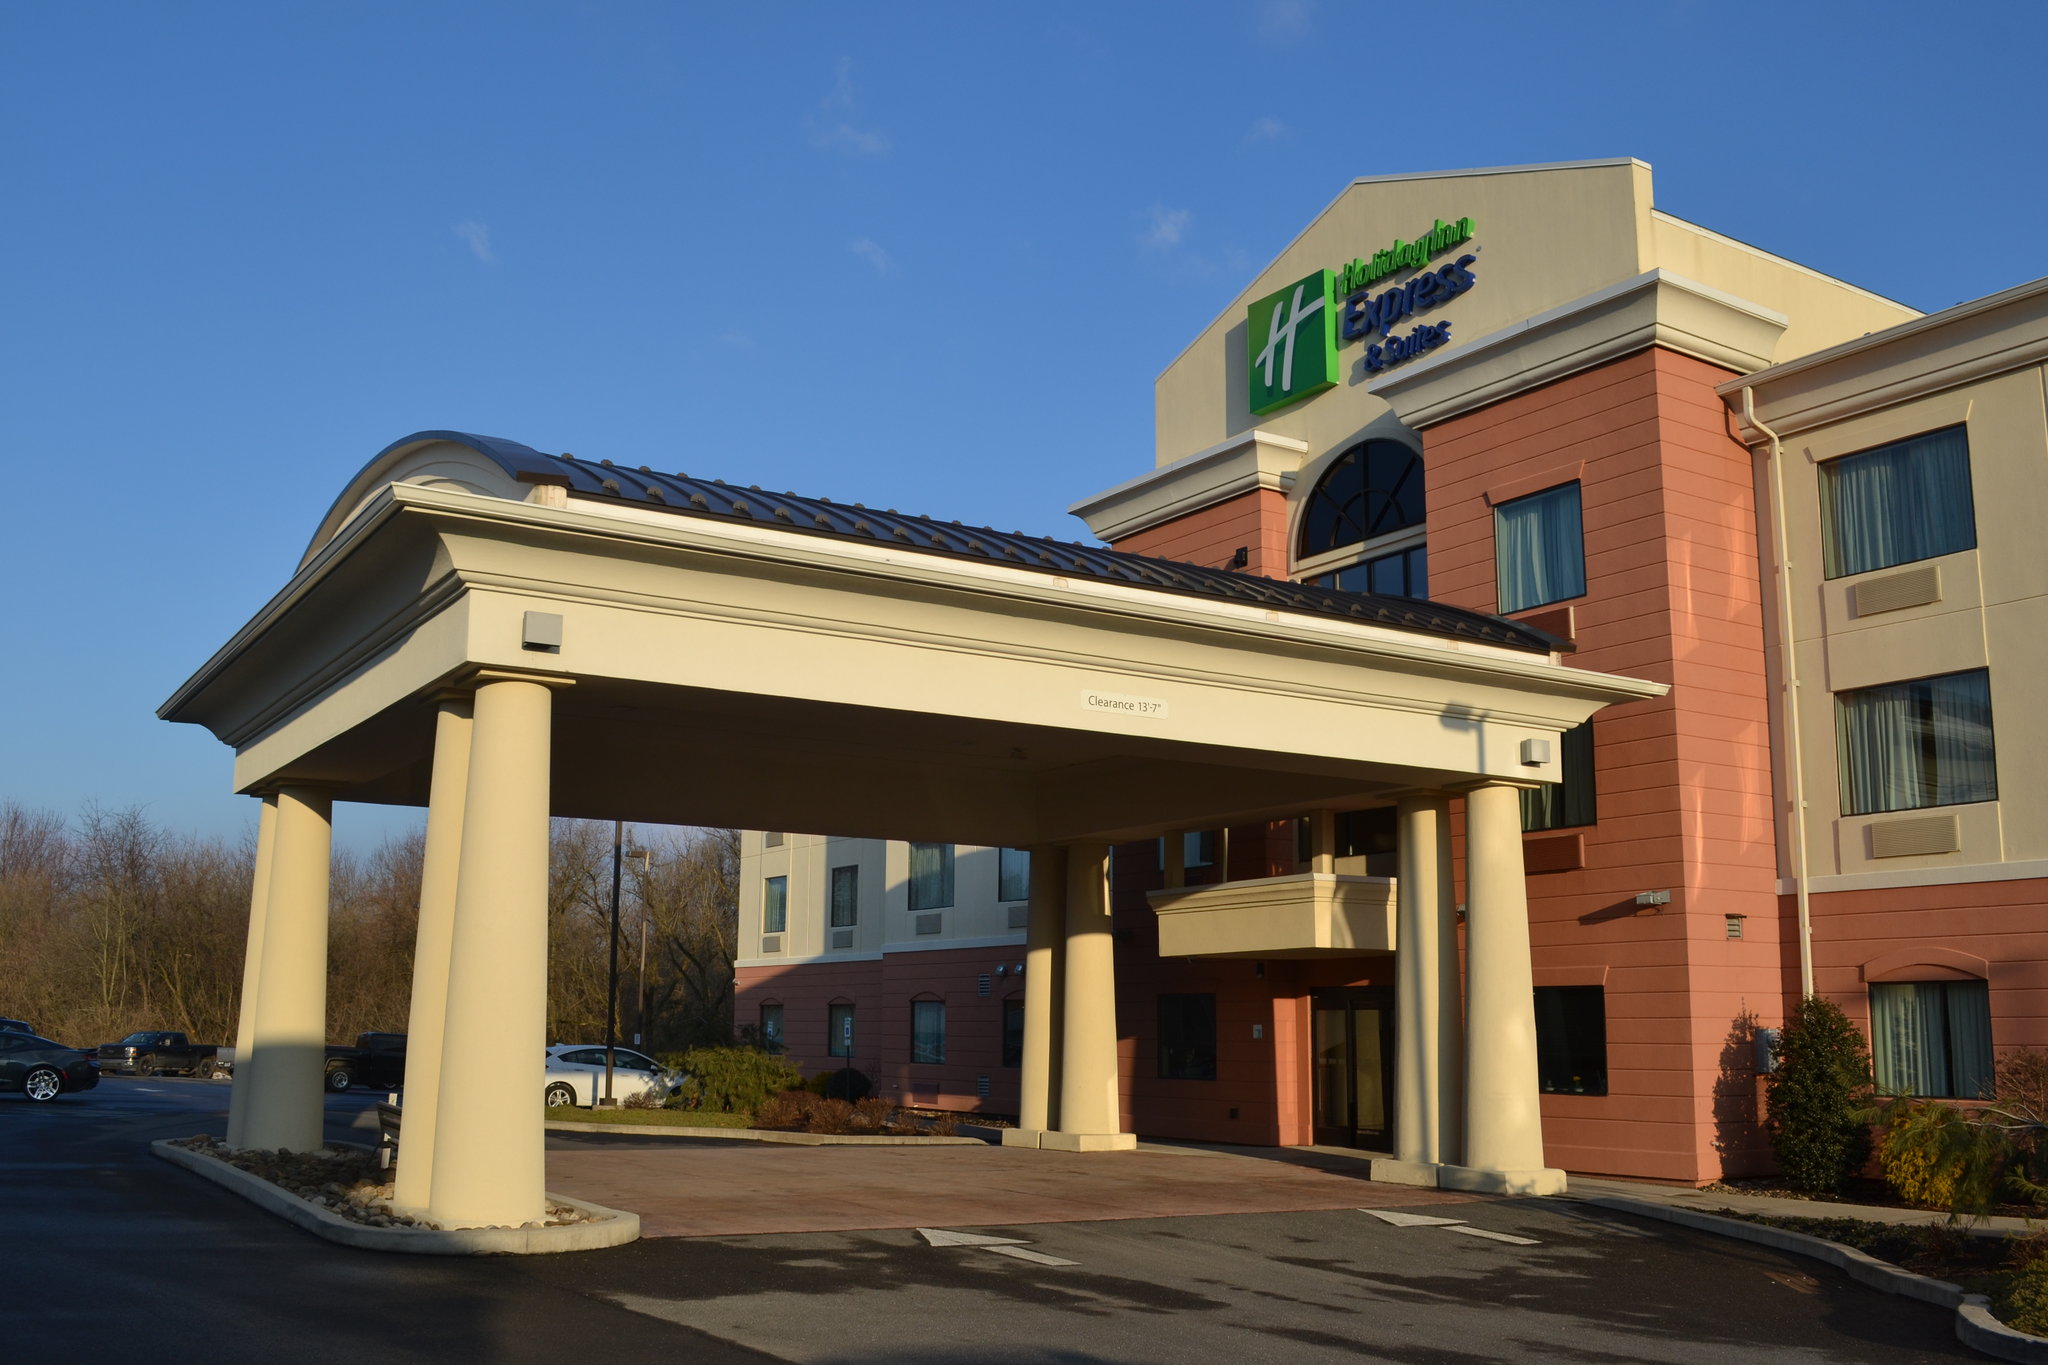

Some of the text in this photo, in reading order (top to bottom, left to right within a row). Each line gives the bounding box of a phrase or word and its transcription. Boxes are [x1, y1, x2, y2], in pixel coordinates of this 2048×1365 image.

[1340, 217, 1476, 295] Holiday Inn
[1343, 254, 1476, 340] Express
[1364, 320, 1453, 373] & Suites
[1088, 696, 1161, 713] Clearance 13'-7"
